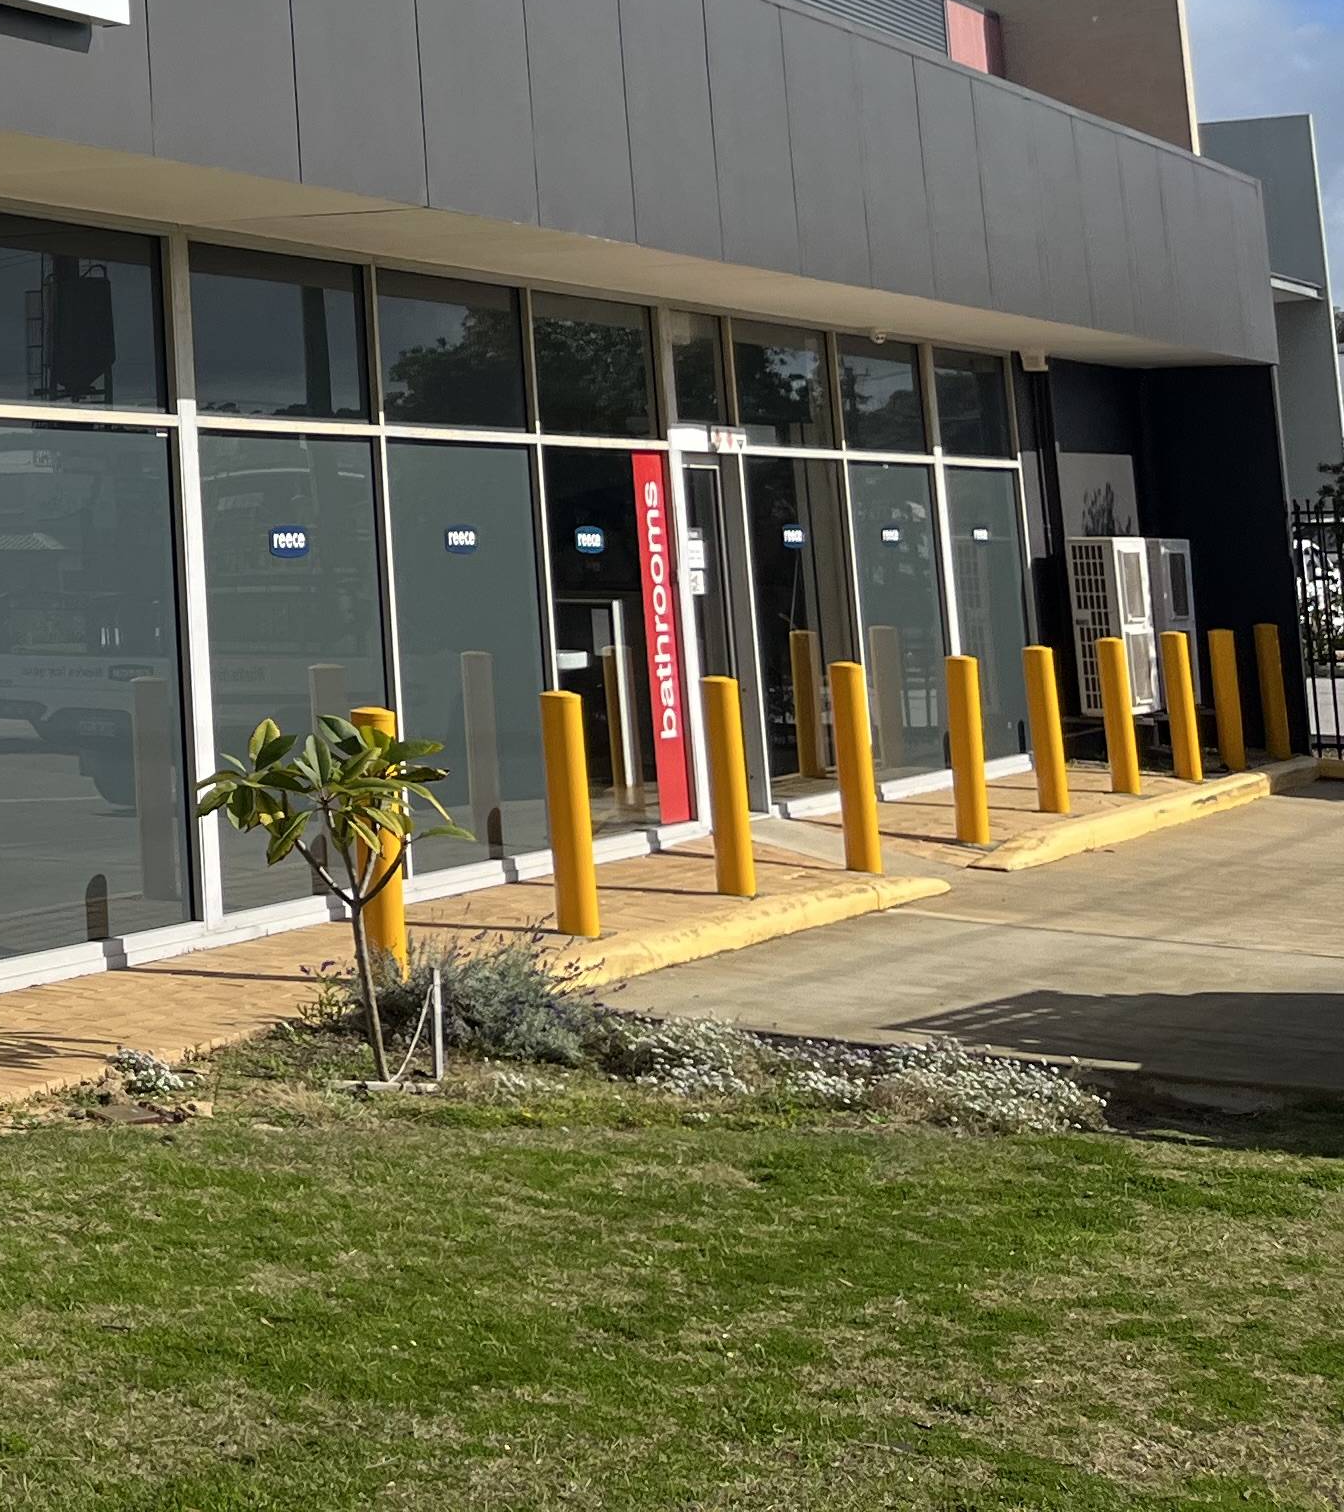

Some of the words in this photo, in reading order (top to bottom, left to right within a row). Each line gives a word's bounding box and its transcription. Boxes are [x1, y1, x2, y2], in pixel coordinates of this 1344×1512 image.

[272, 530, 306, 550] reece
[447, 529, 476, 548] reece
[644, 480, 678, 740] bathrooms
